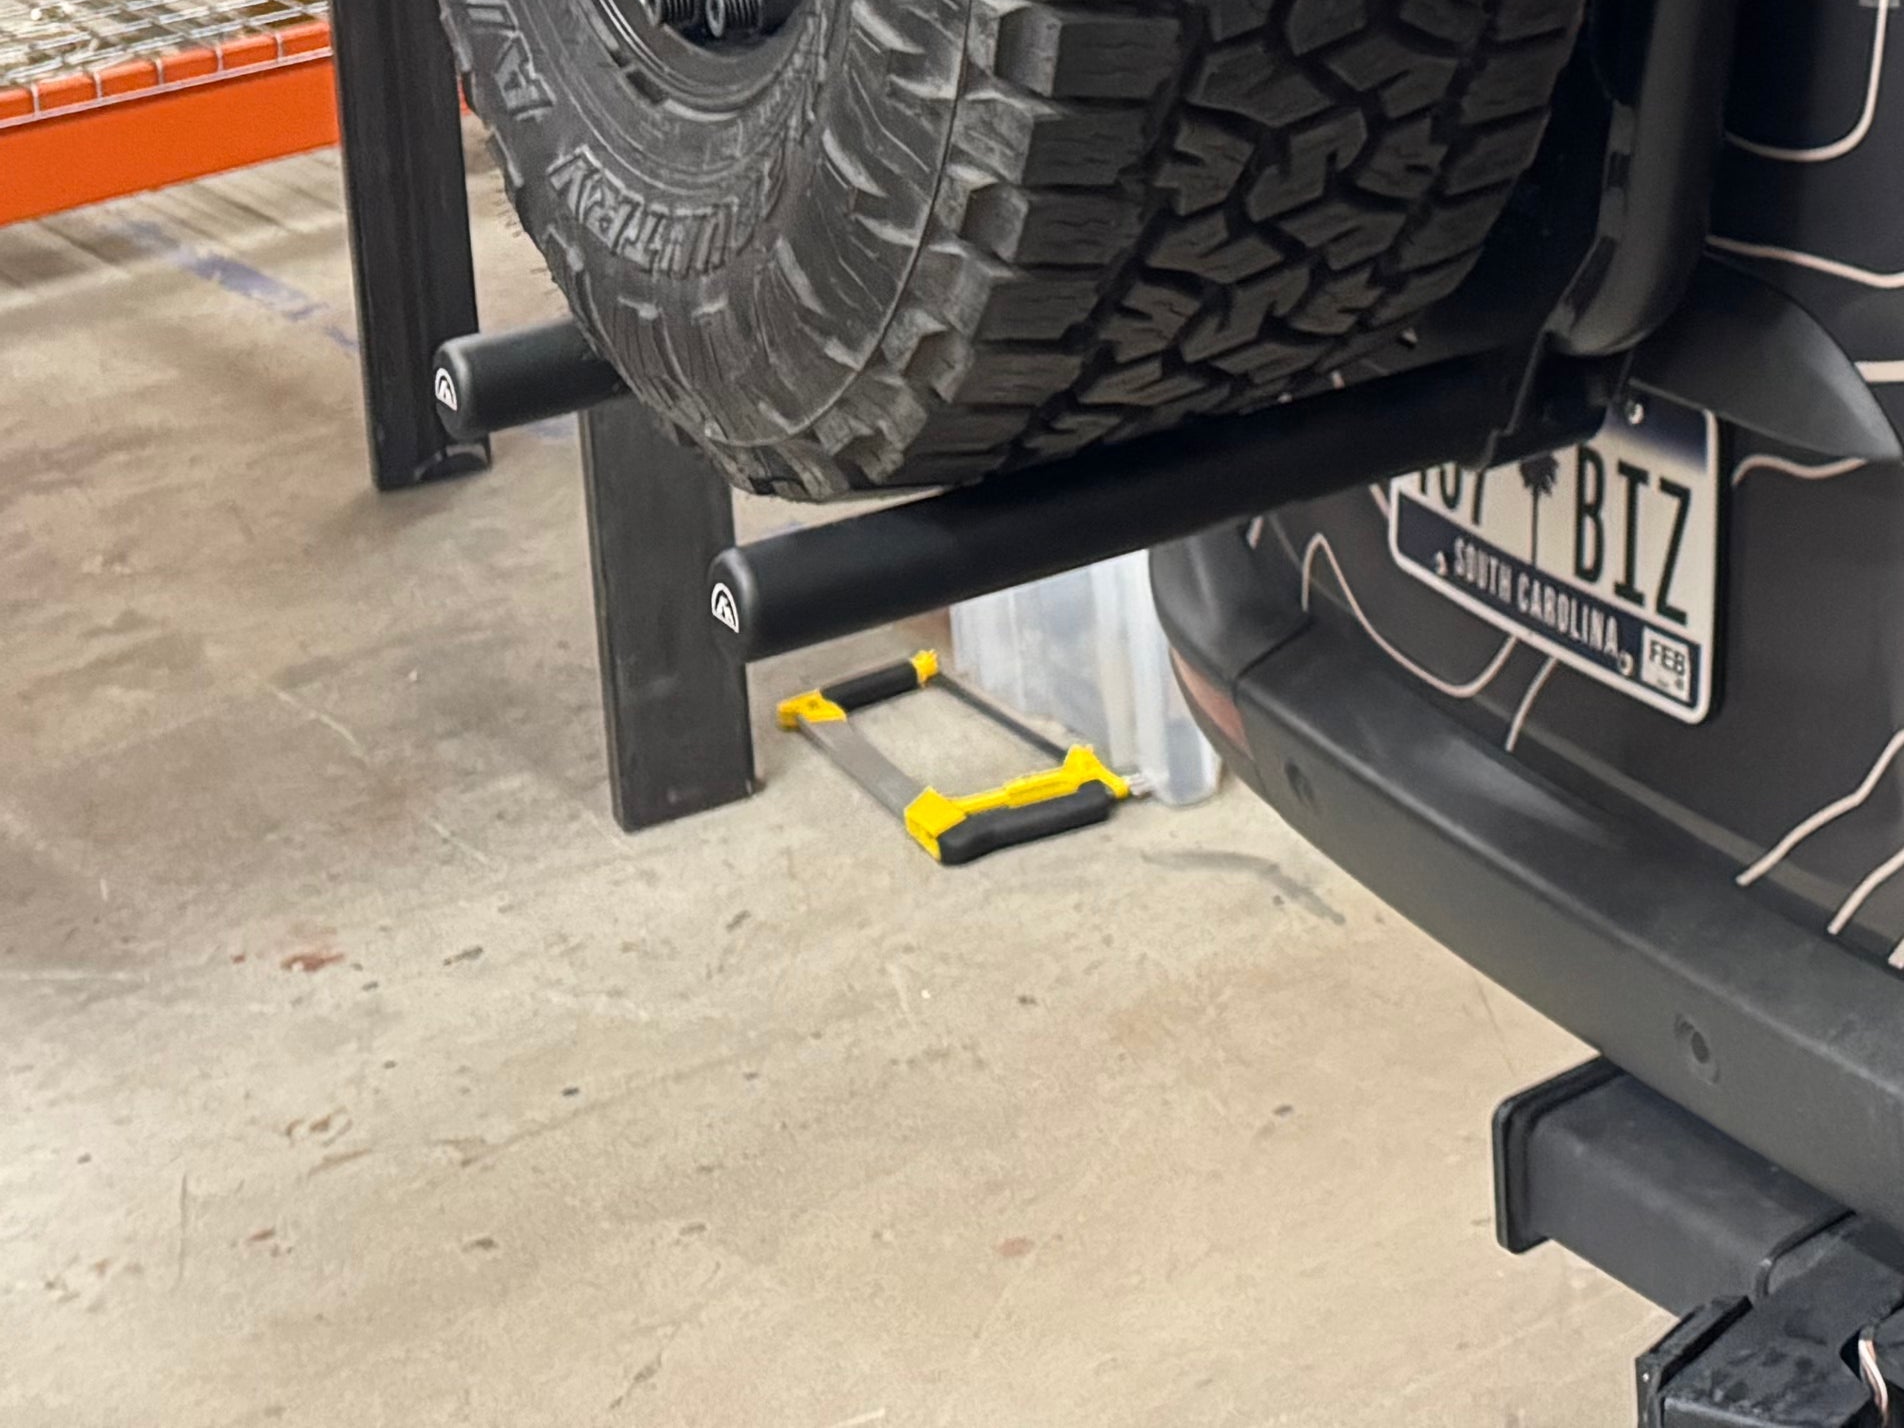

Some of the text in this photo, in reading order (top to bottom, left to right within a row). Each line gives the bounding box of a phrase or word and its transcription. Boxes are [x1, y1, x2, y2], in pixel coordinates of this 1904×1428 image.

[1573, 444, 1692, 627] BIZ
[1453, 536, 1621, 659] SOUTH CAROLINA
[1649, 638, 1686, 676] FEB
